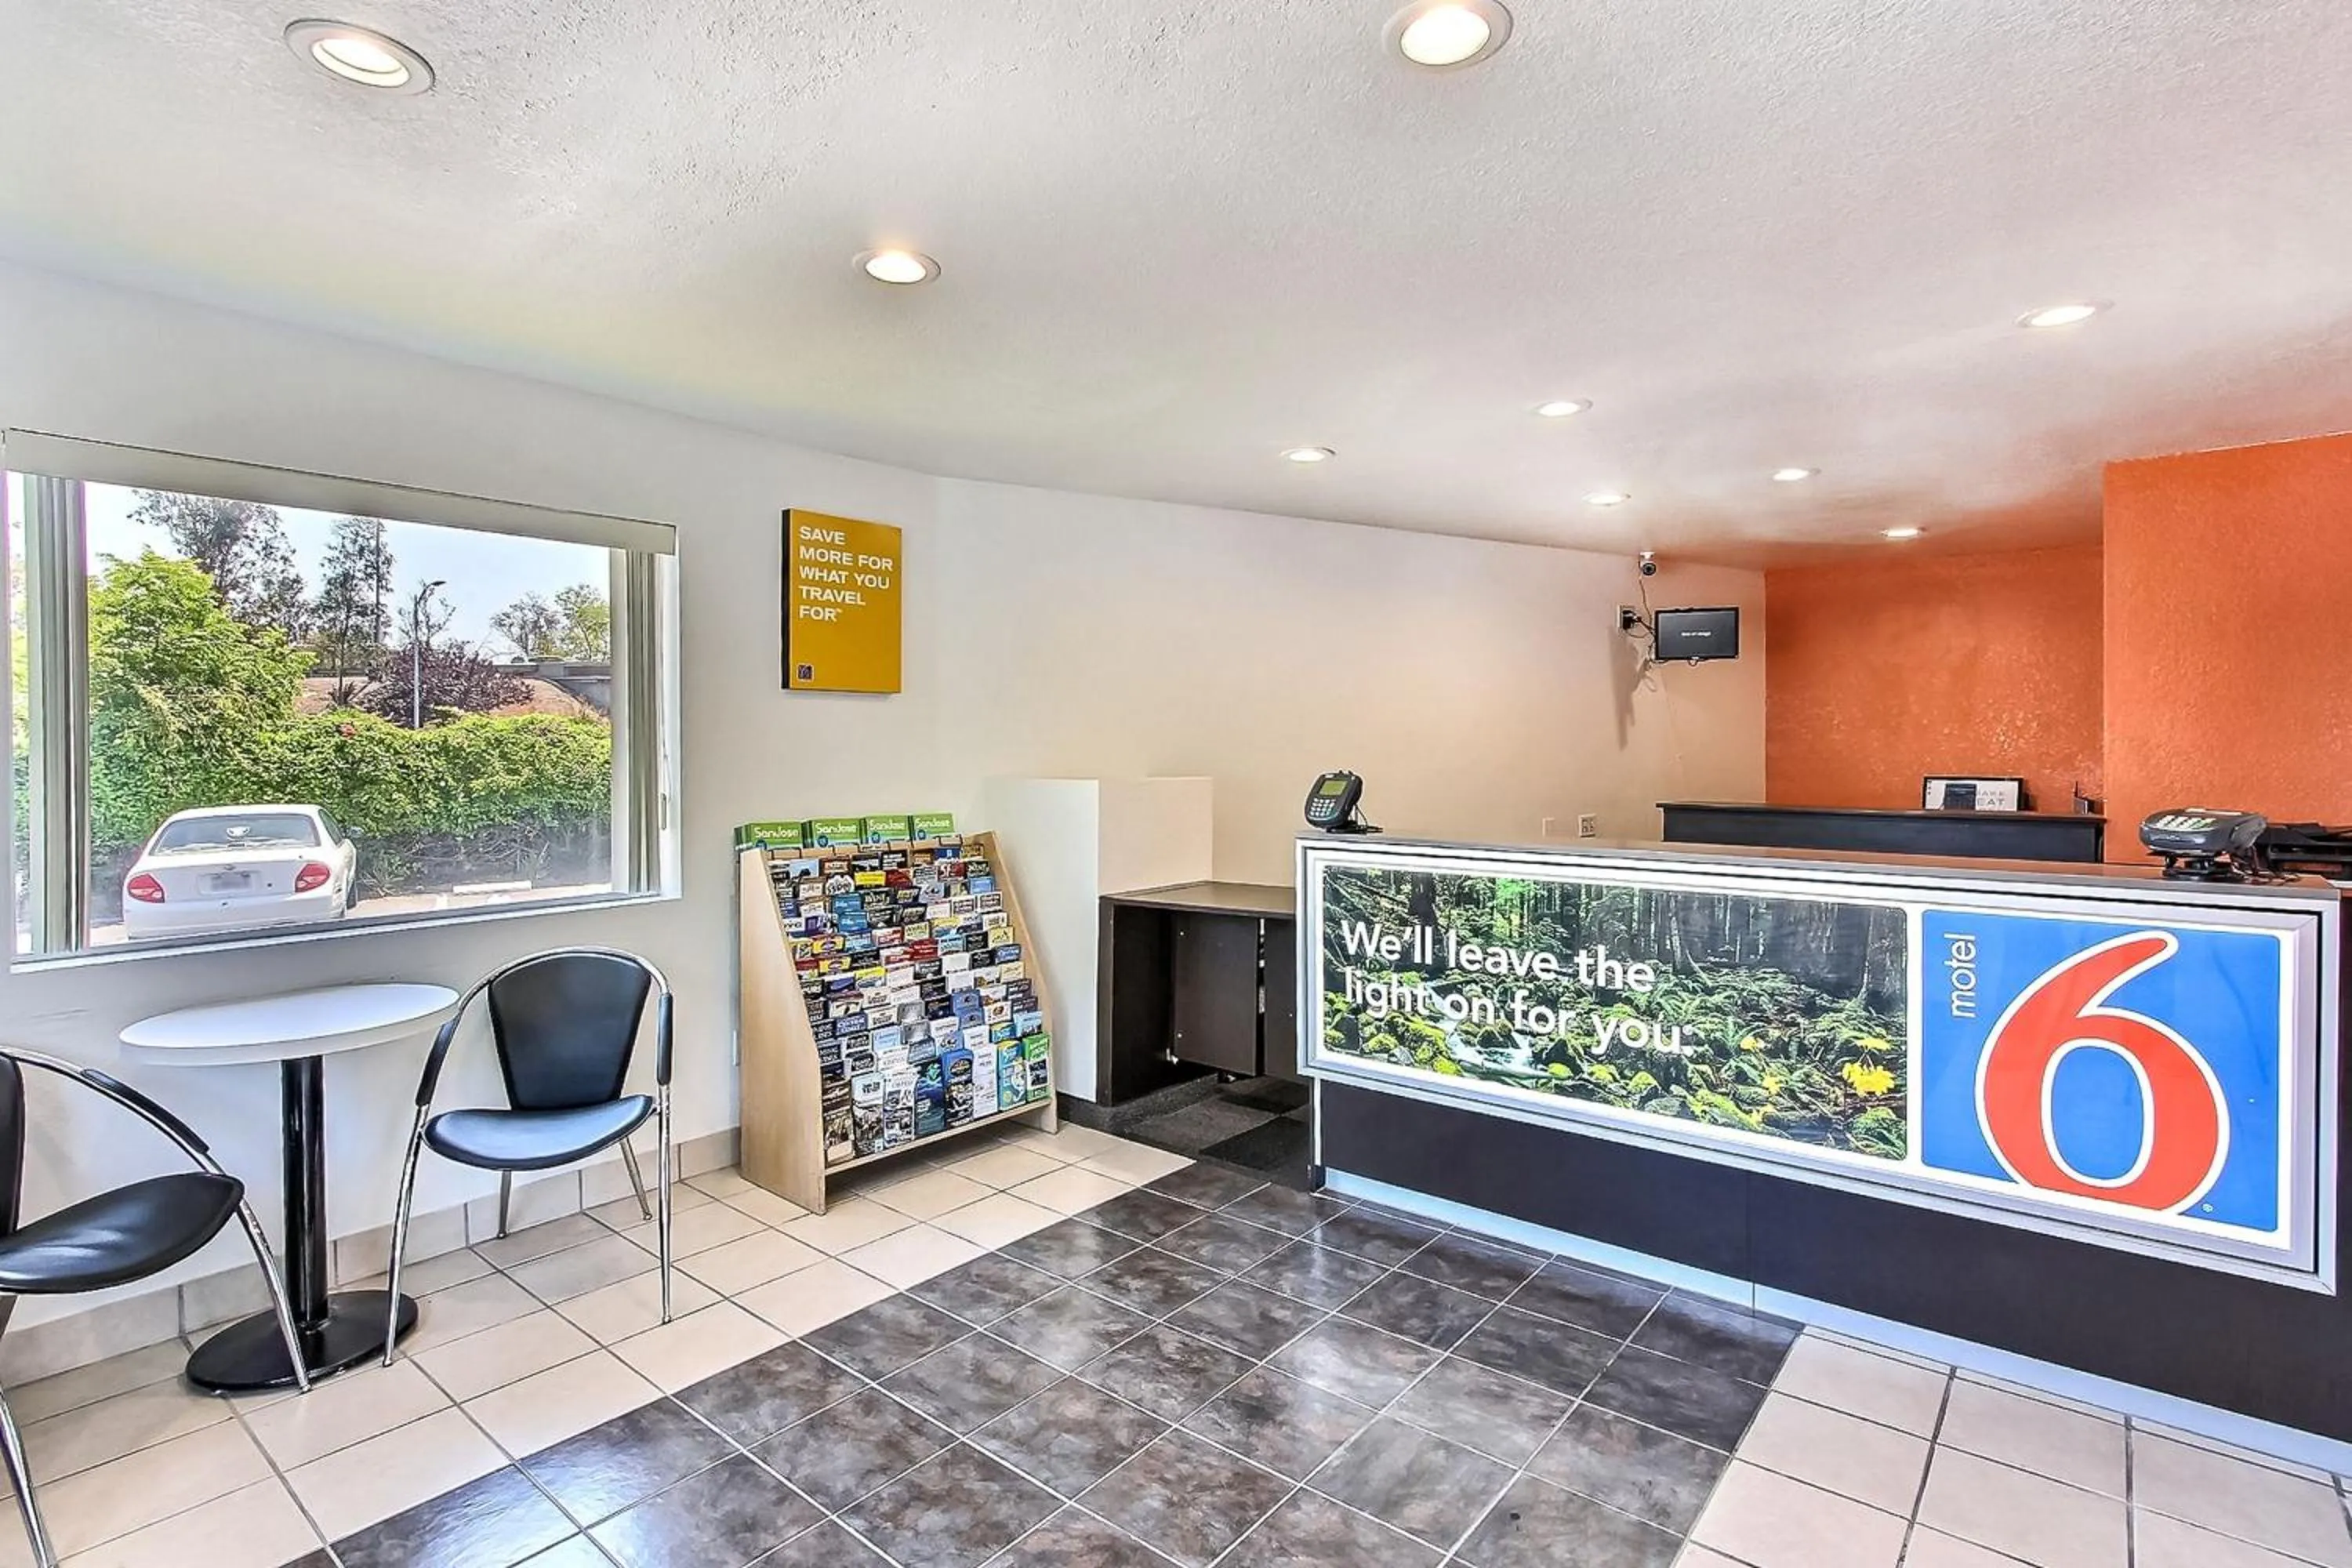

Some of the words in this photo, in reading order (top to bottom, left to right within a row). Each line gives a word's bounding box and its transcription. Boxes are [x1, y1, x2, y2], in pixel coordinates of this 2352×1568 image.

[799, 525, 846, 545] SAVE
[799, 545, 854, 566] MORE
[858, 554, 894, 572] FOR
[799, 565, 849, 585] WHAT
[854, 573, 891, 590] YOU
[799, 585, 866, 605] TRAVEL
[1341, 920, 1433, 965] We'll
[1448, 928, 1559, 980] leave
[1573, 944, 1655, 993] the
[1944, 933, 1976, 1018] motel
[1343, 966, 1429, 1018] light
[1445, 993, 1496, 1025] on
[1509, 989, 1577, 1036] for
[1974, 930, 2230, 1215] 6
